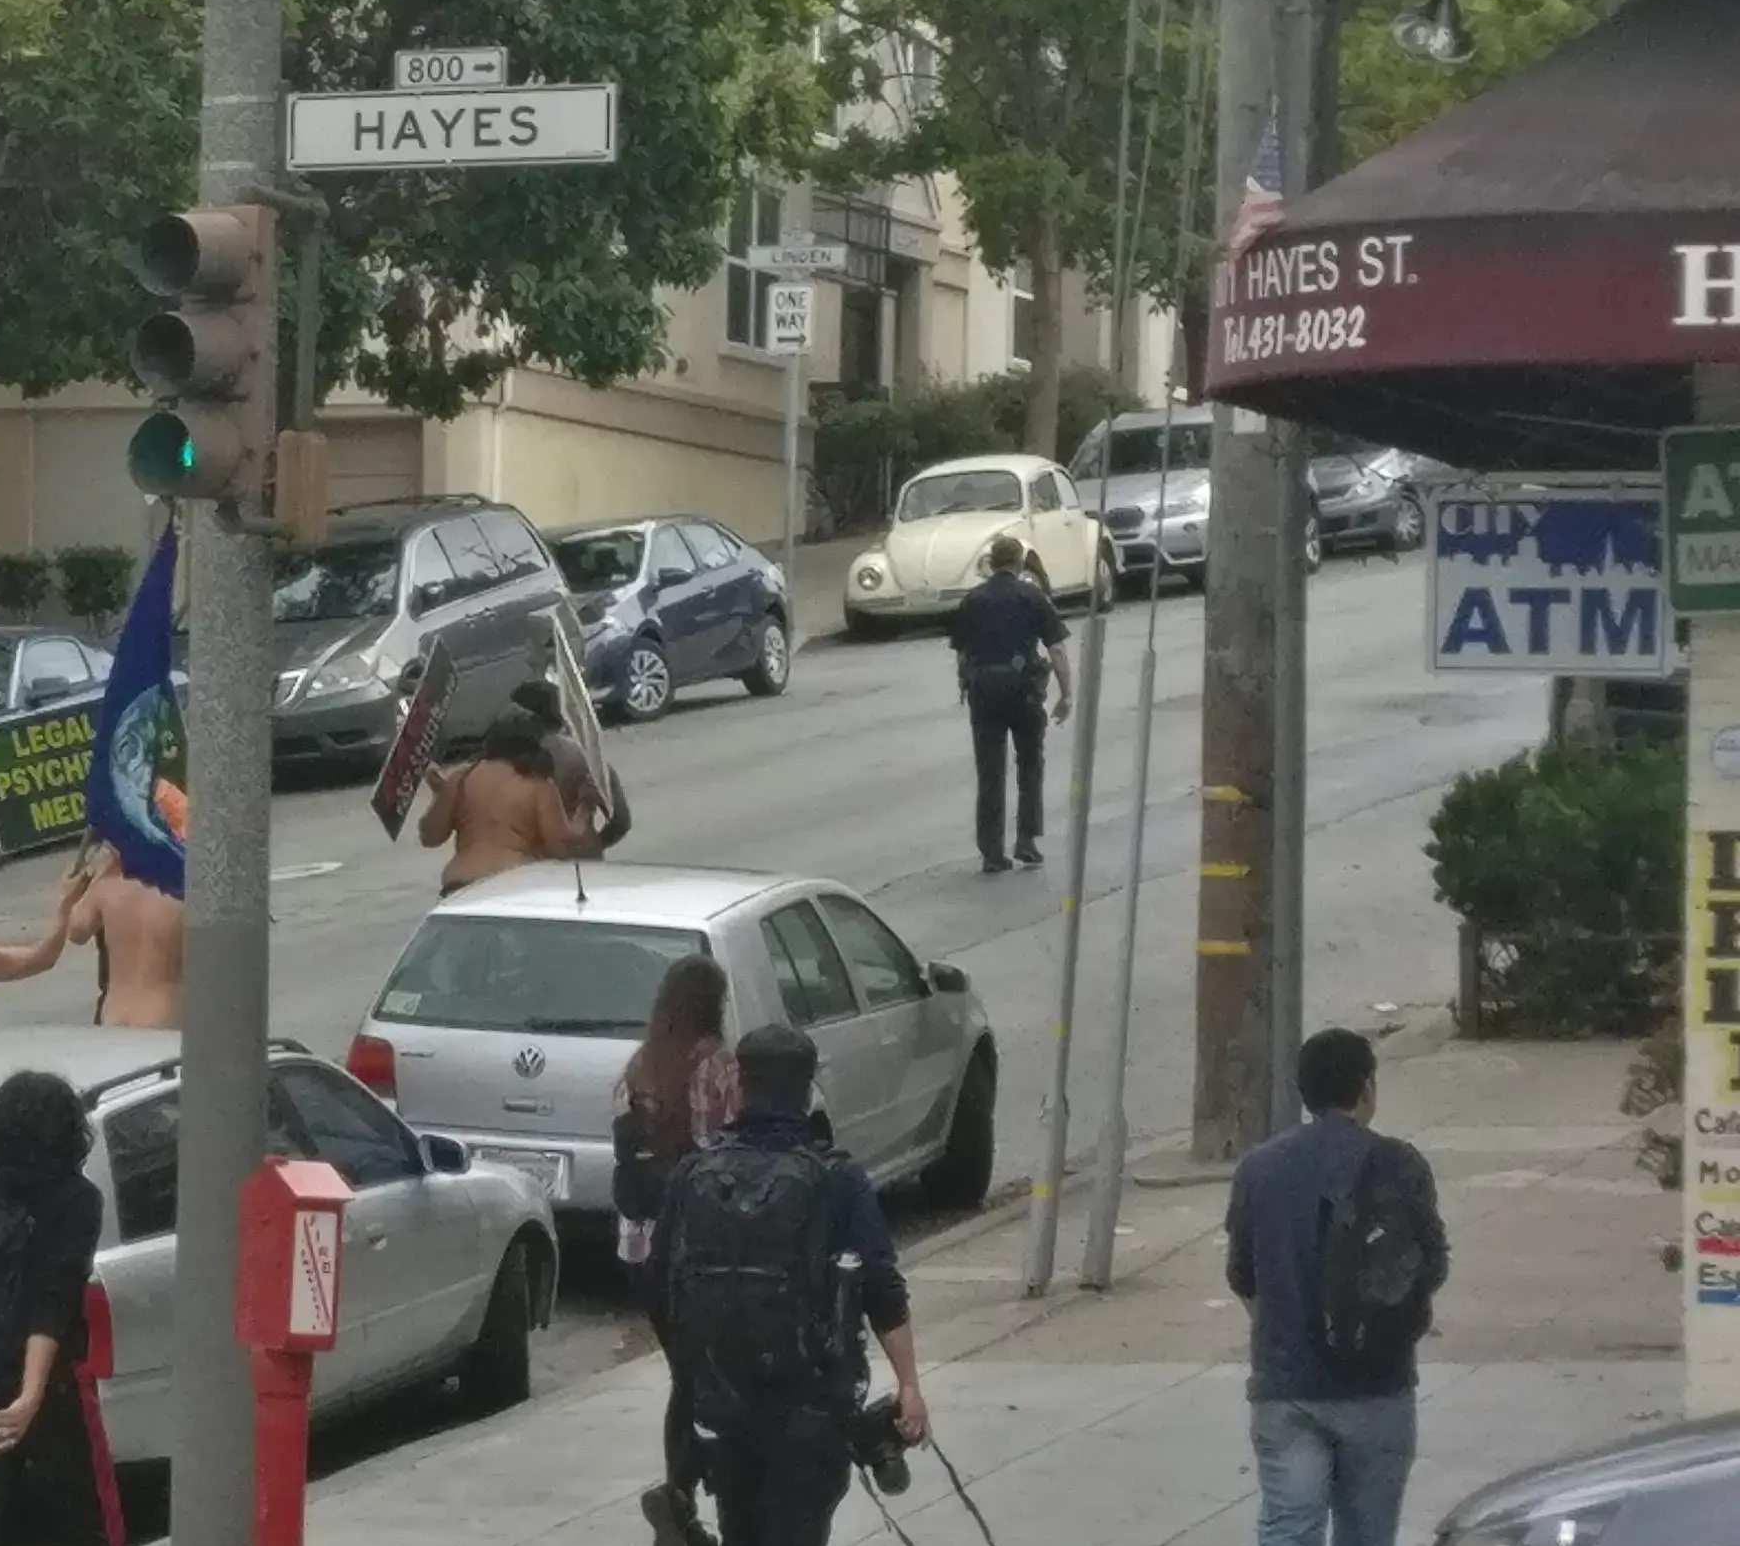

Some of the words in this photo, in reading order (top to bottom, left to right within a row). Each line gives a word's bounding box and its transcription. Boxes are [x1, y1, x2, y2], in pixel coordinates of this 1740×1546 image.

[407, 56, 464, 83] 800
[354, 106, 539, 150] HAYES
[1246, 241, 1339, 301] HAYES
[1358, 235, 1418, 286] ST.
[774, 290, 808, 310] ONE
[774, 311, 808, 330] WAY
[1440, 586, 1658, 654] ATM
[10, 712, 96, 759] LEGAL
[29, 792, 86, 832] MED
[1698, 1159, 1740, 1184] Mo
